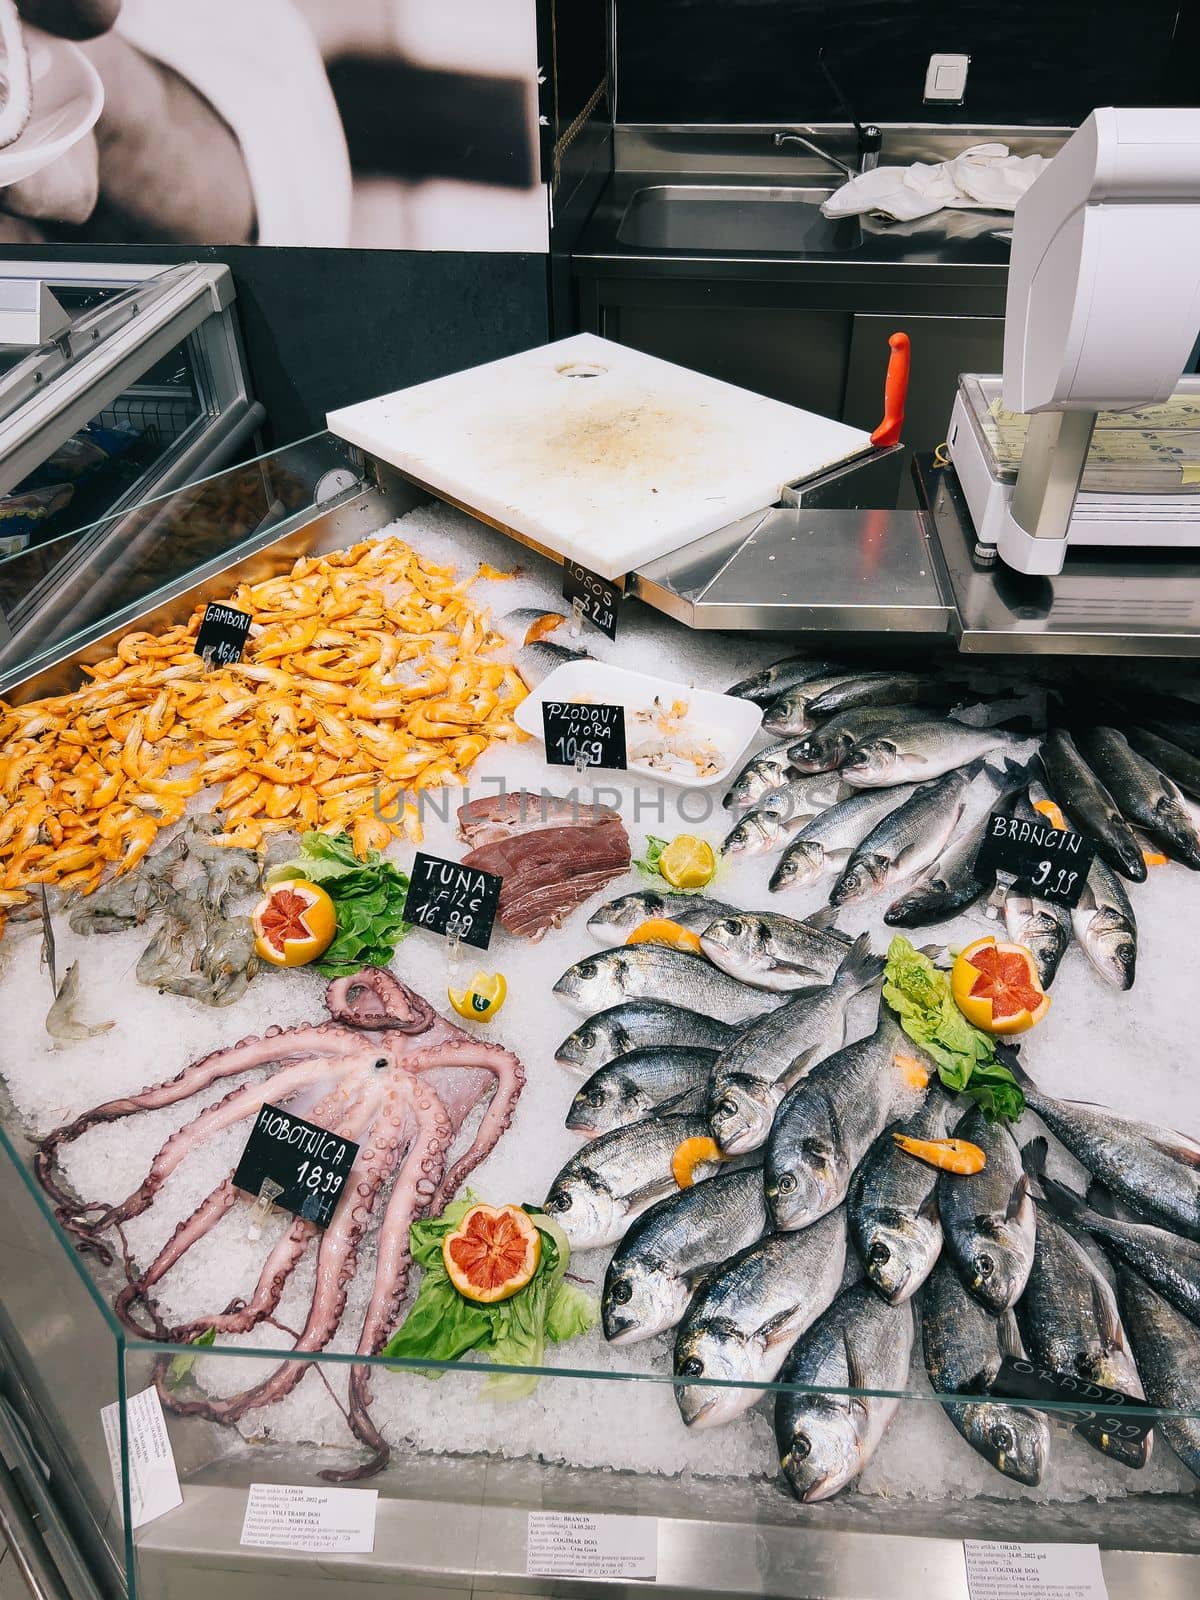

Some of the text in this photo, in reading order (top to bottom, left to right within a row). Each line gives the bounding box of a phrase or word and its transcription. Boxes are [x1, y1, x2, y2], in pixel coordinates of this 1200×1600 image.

[568, 560, 613, 607] LOSOS
[205, 605, 251, 630] GAMBORI
[546, 703, 619, 723] PLODOVI
[567, 722, 611, 739] MORA
[992, 816, 1083, 854] BRANCIN
[423, 861, 486, 897] TUNA
[1031, 860, 1079, 896] 9,99
[434, 889, 482, 911] FILE
[258, 1110, 346, 1165] HOBOTNICA
[296, 1161, 343, 1195] 18,99
[1012, 1361, 1125, 1406] ORADA
